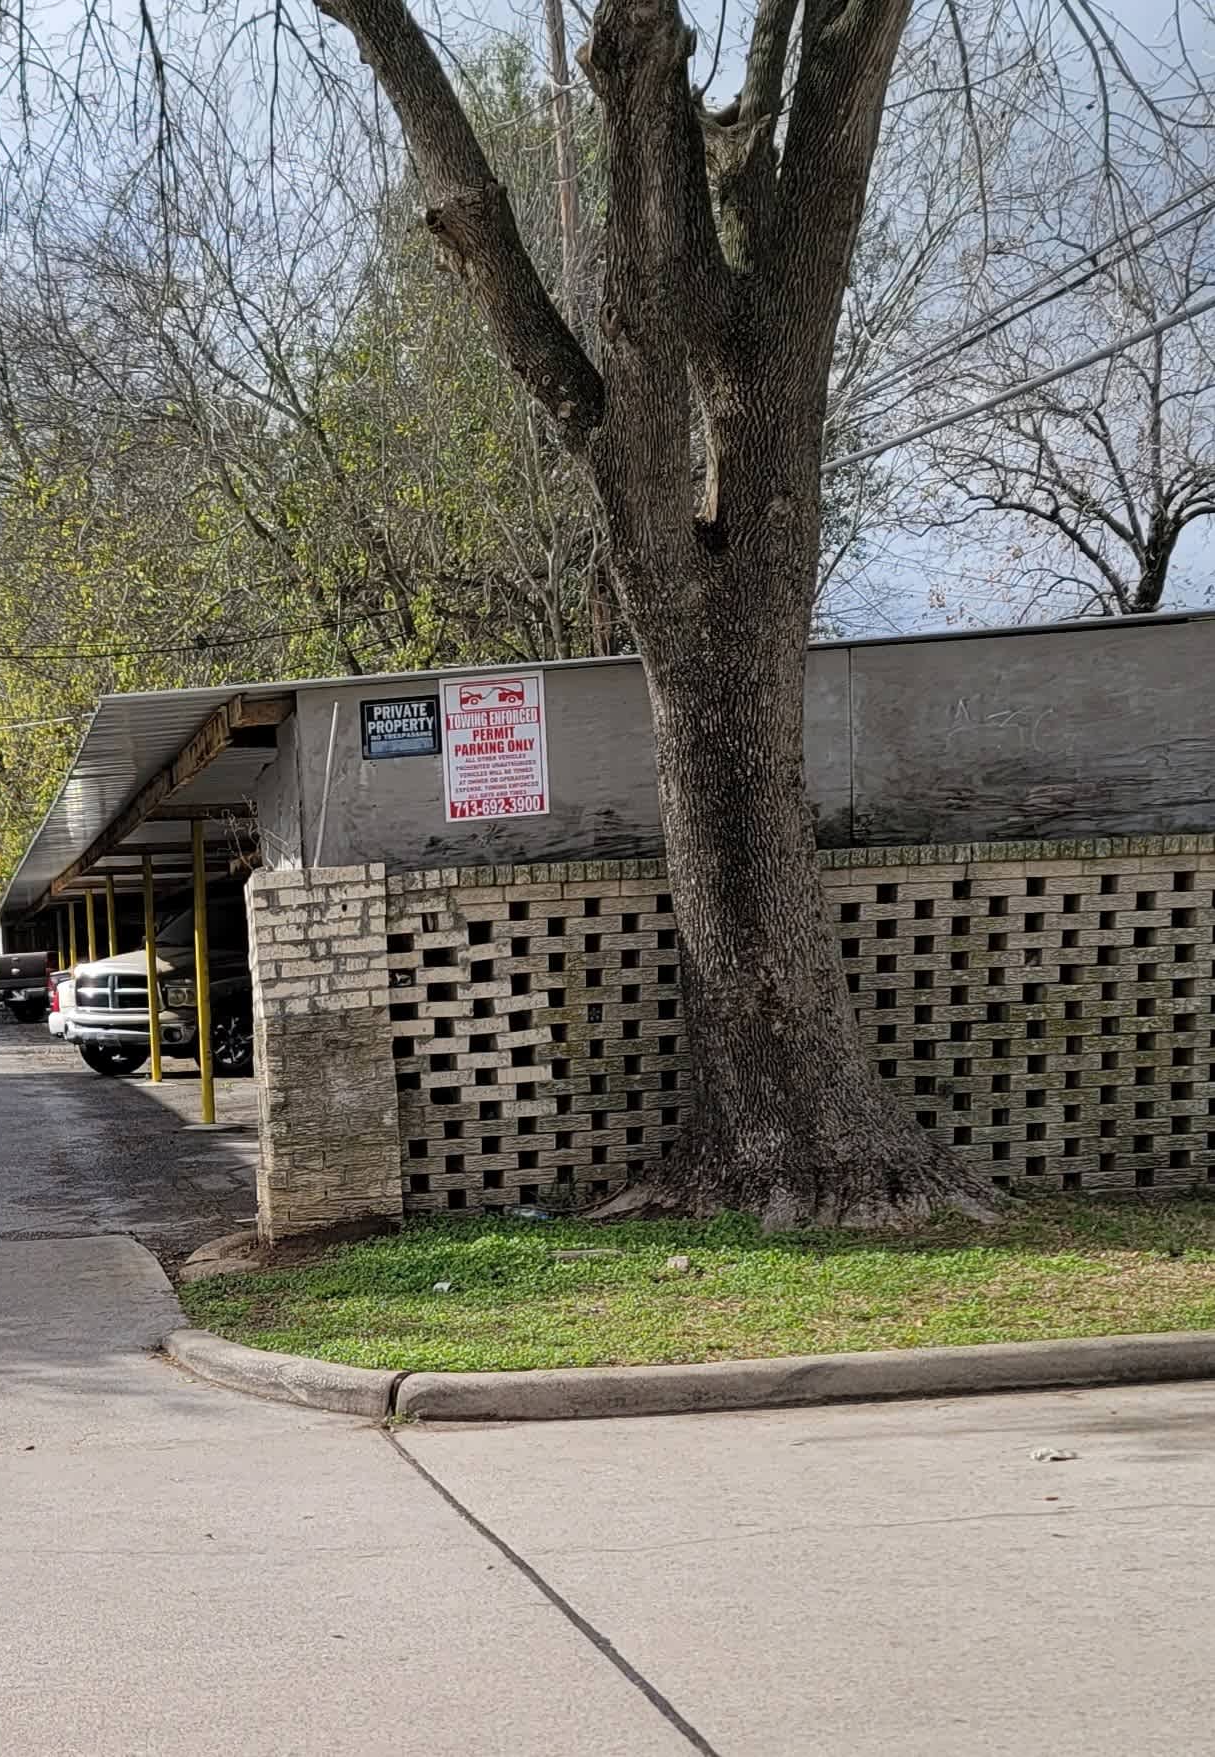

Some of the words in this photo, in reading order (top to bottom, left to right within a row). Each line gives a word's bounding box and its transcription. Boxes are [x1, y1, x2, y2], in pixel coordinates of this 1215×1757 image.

[373, 703, 427, 720] PRIVATE
[448, 712, 488, 729] TOWING
[489, 708, 538, 726] ENFORCED
[368, 716, 434, 735] PROPERTY
[473, 727, 515, 741] PERMIT
[455, 741, 504, 757] PARKING
[507, 738, 535, 752] ONLY
[454, 796, 541, 817] 713-692-3900
